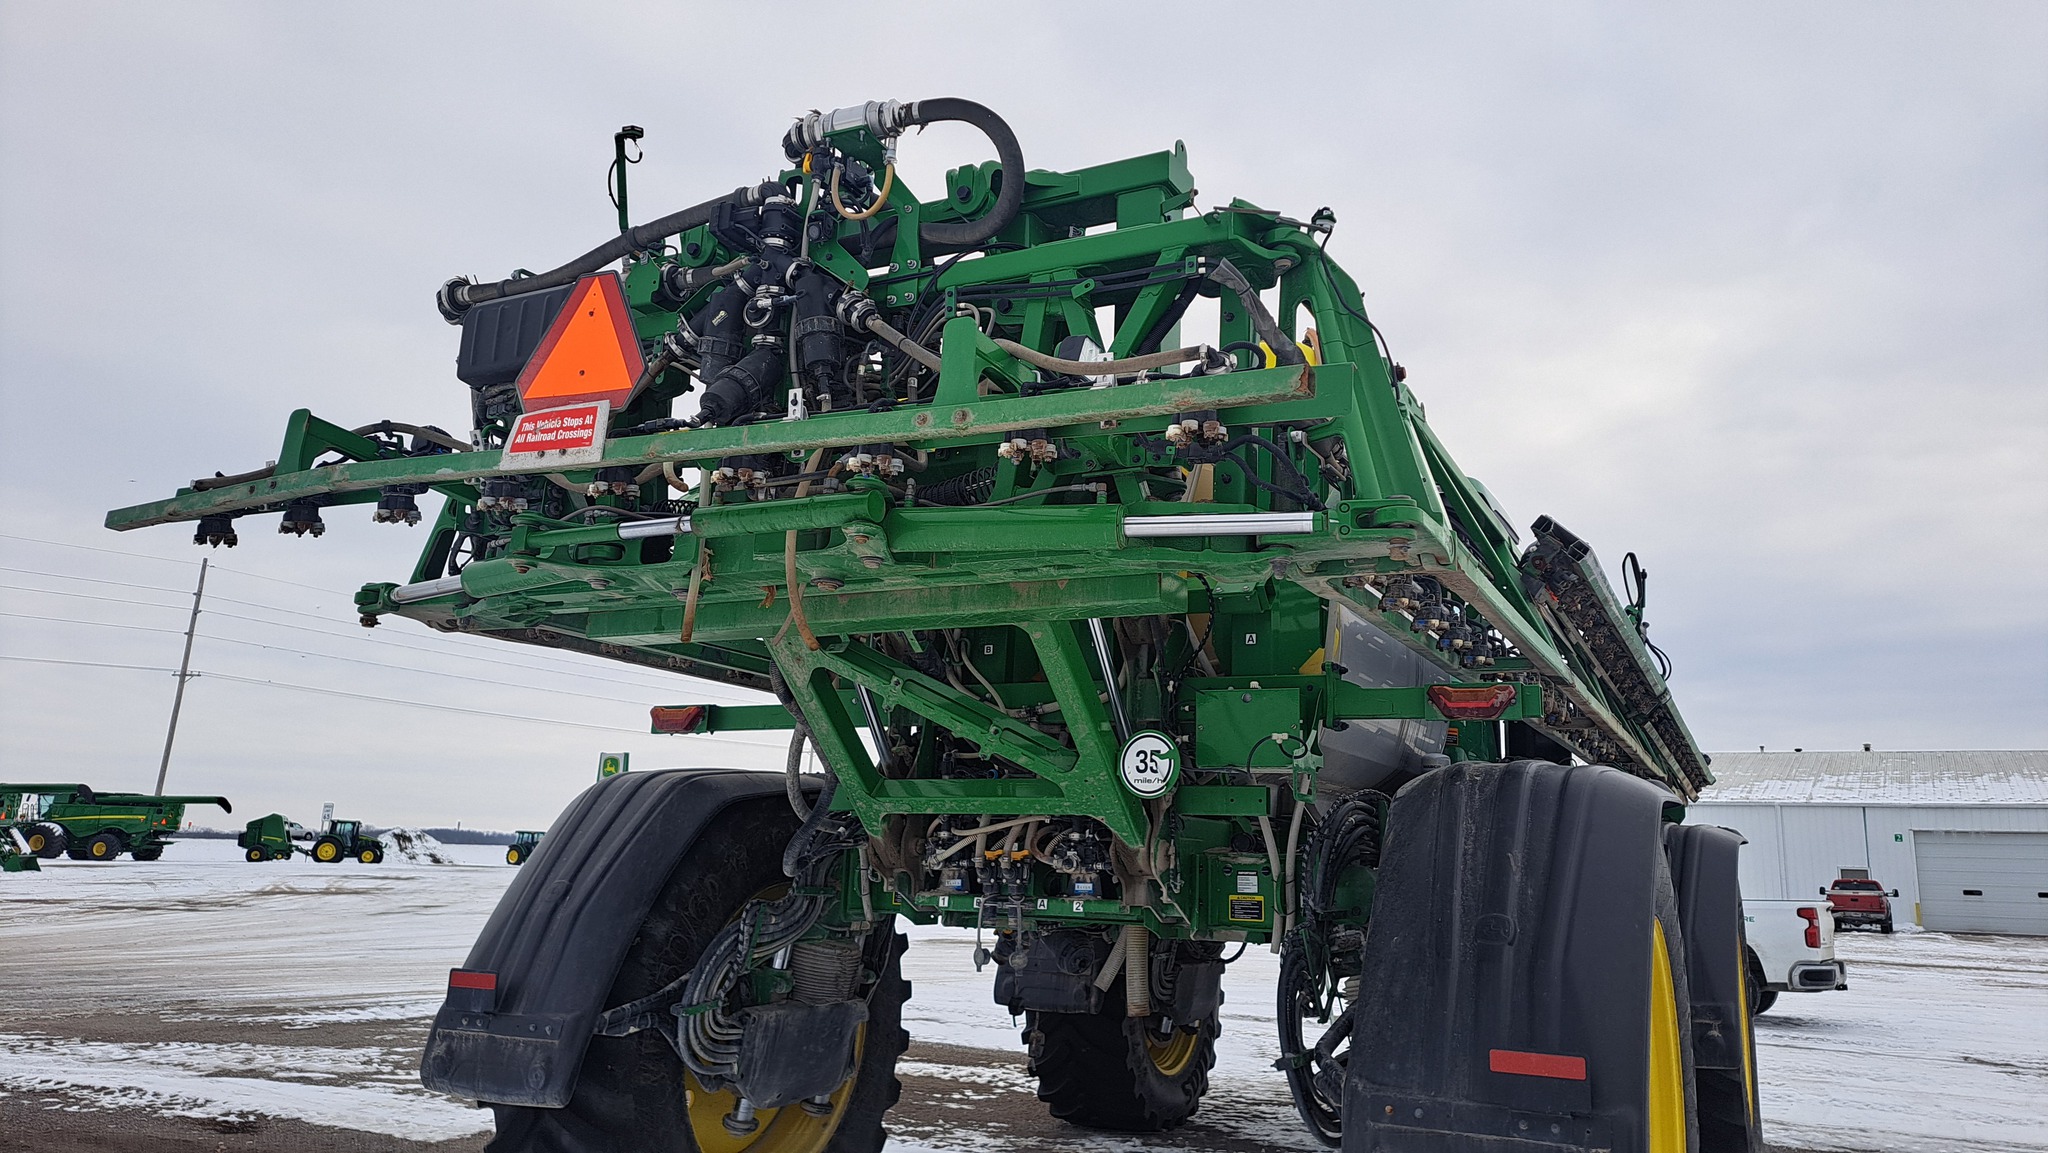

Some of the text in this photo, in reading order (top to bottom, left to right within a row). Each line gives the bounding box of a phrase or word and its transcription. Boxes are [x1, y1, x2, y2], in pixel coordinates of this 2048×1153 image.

[521, 414, 593, 431] This Vehicle Stops At
[514, 427, 593, 444] All Railroad Crossings
[1246, 634, 1255, 644] A
[1135, 749, 1161, 774] 35
[1038, 899, 1046, 909] A
[1075, 901, 1082, 911] 2
